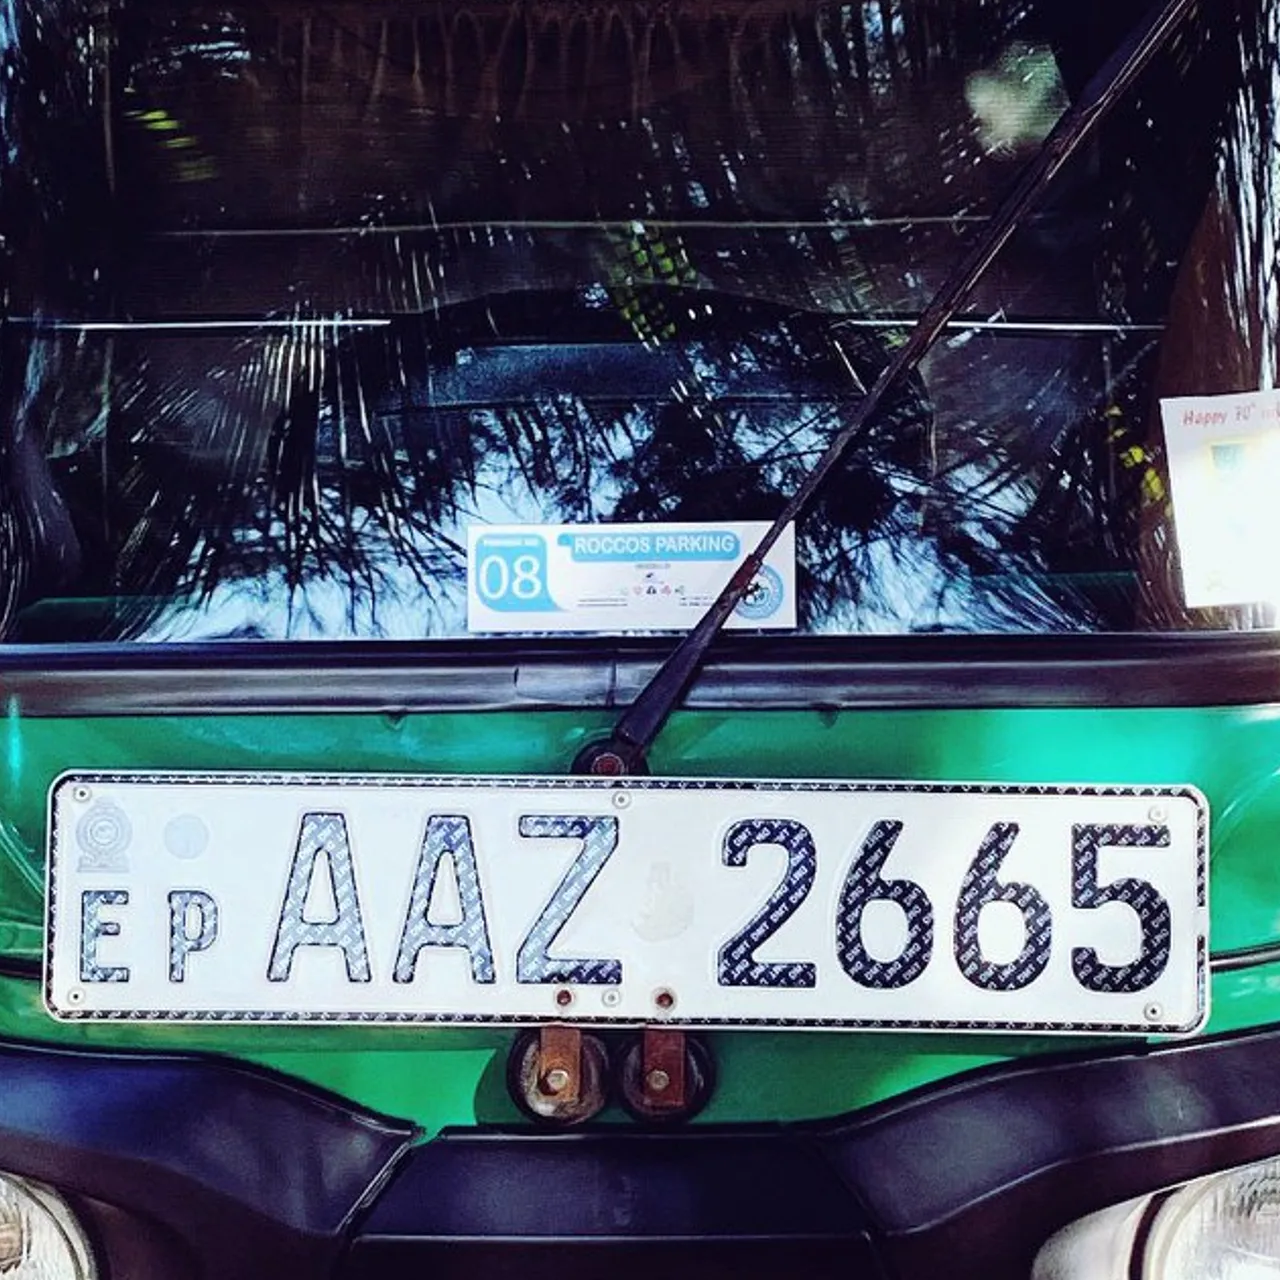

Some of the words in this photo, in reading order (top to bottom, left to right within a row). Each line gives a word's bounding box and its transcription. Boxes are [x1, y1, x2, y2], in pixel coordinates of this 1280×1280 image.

[574, 536, 650, 554] ROCCOS
[655, 534, 735, 552] PARKING
[478, 554, 542, 601] 08
[79, 888, 219, 982] EP
[266, 810, 623, 985] AAZ
[717, 819, 1171, 991] 2665
